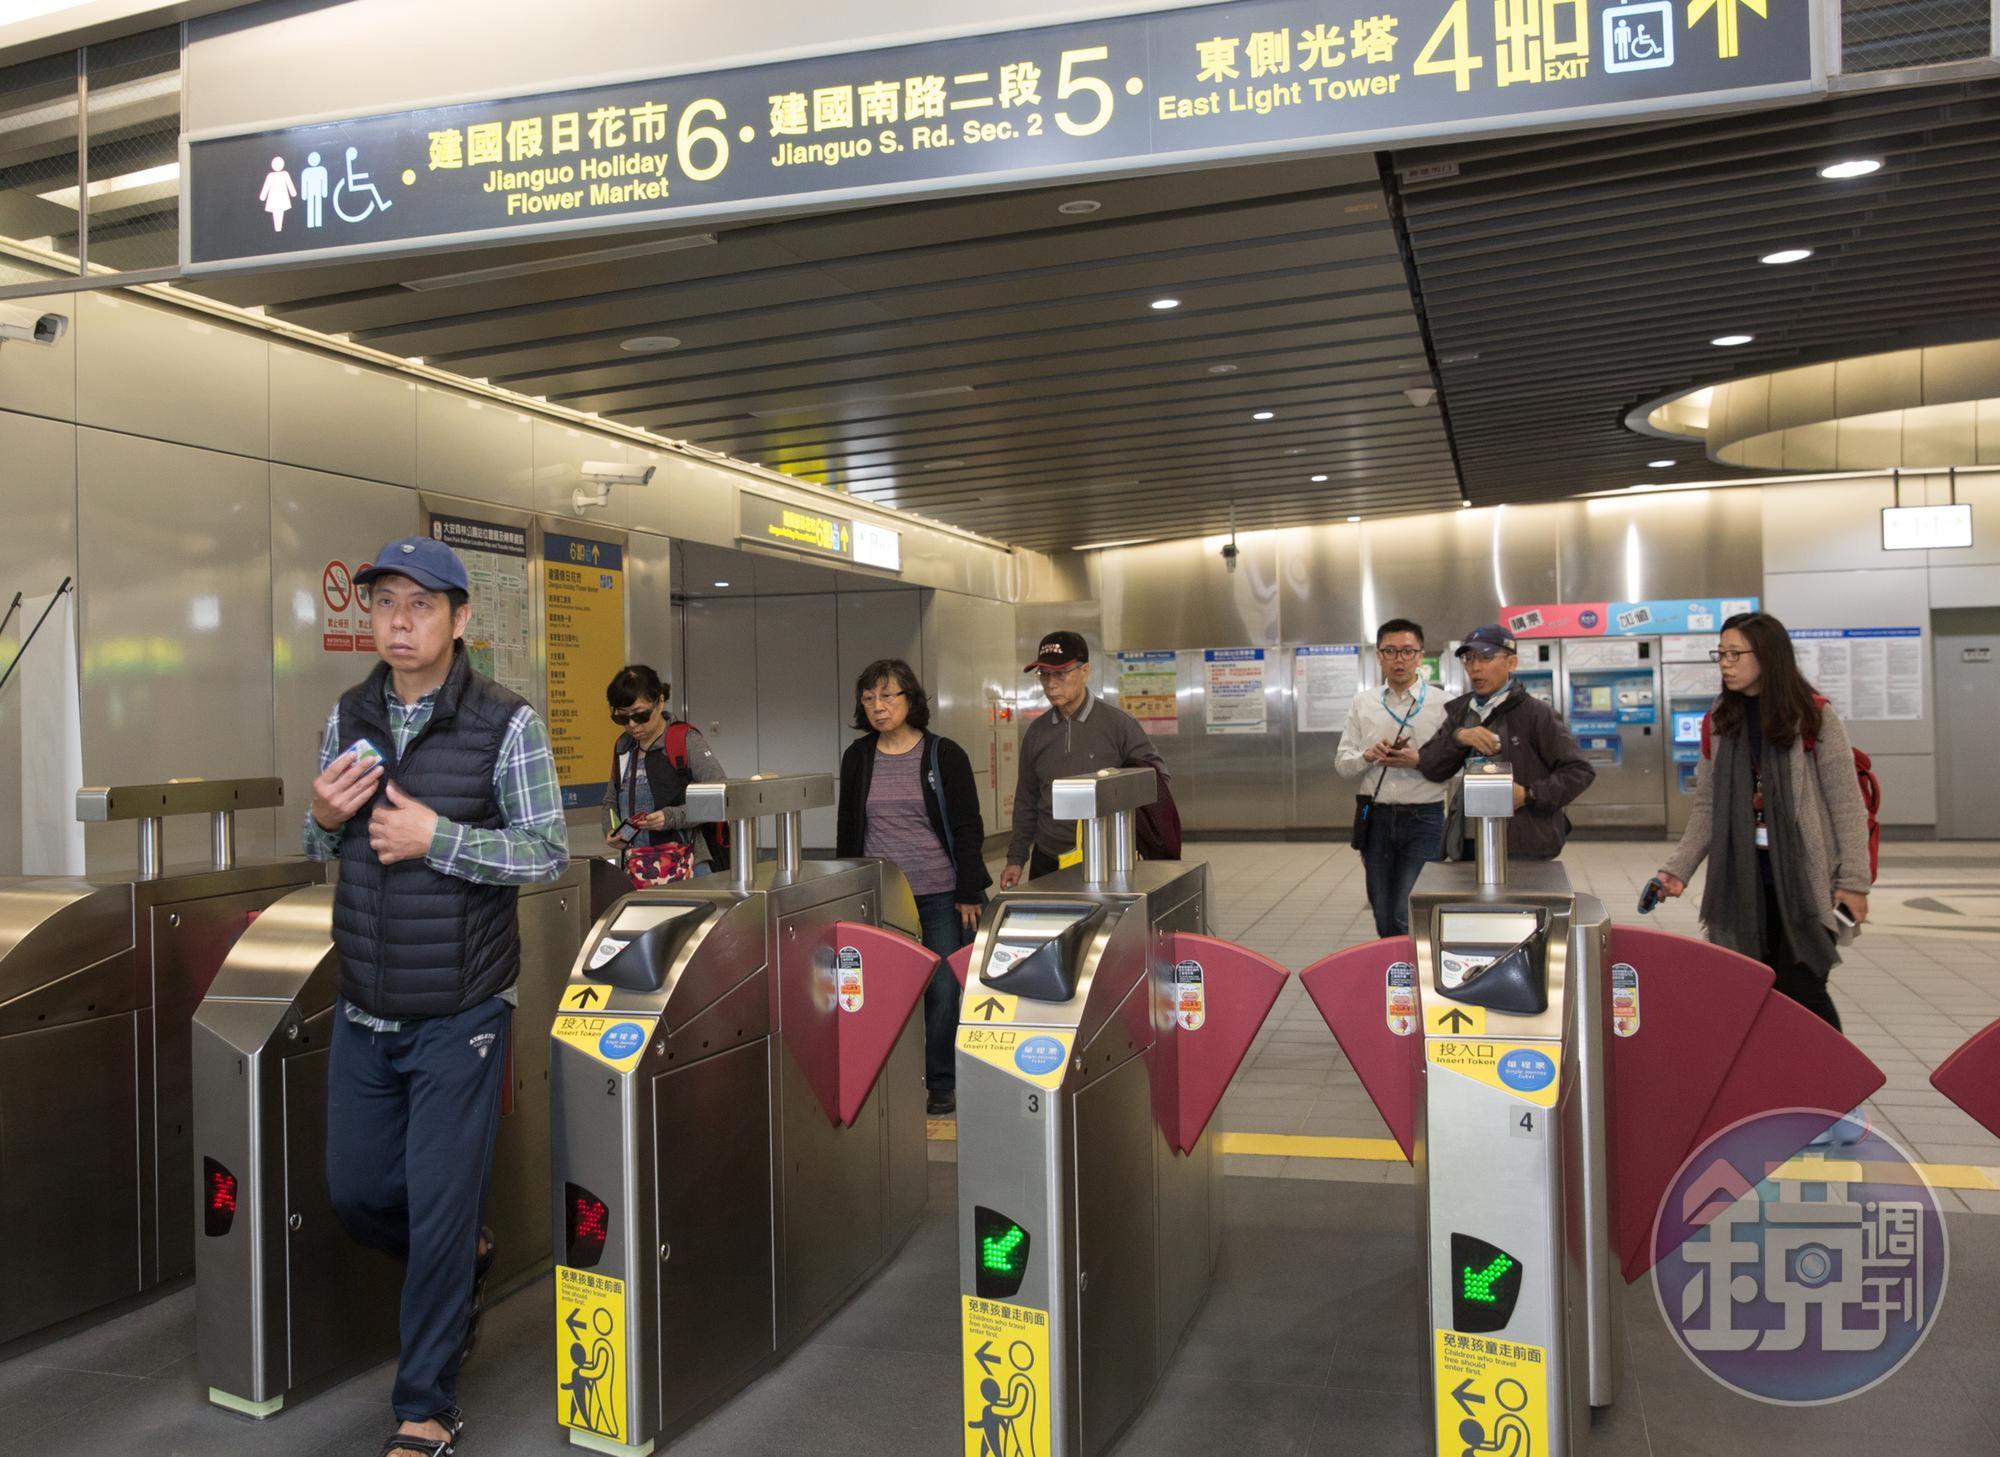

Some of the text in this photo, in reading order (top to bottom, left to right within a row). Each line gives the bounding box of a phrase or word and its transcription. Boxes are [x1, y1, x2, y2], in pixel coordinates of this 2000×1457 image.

[1196, 15, 1399, 83] 東側光塔
[1413, 0, 1483, 92] 4
[1494, 0, 1590, 87] 出口
[1544, 58, 1590, 81] EXIT
[769, 62, 1042, 138] 建國南路二段
[1054, 46, 1114, 136] 5
[1158, 73, 1400, 120] East Light Tower
[428, 103, 668, 171] 建國假日花市
[676, 98, 729, 181] 6
[771, 113, 1043, 166] Jianguo S. Rd. Sec. 2
[483, 152, 669, 192] Jianguo Holiday
[507, 177, 669, 215] Flower Market
[570, 542, 577, 560] 6
[561, 1018, 605, 1030] 投入口
[968, 1030, 1016, 1044] 投入口
[1437, 1057, 1465, 1065] Insert
[1440, 1043, 1494, 1058] 投入口
[607, 1079, 616, 1096] 2
[1028, 1094, 1039, 1113] 3
[1519, 1112, 1533, 1132] 4
[1444, 1348, 1475, 1359] Children
[1495, 1358, 1517, 1367] travel
[1460, 1359, 1486, 1369] should
[1444, 1364, 1482, 1376] enter first.
